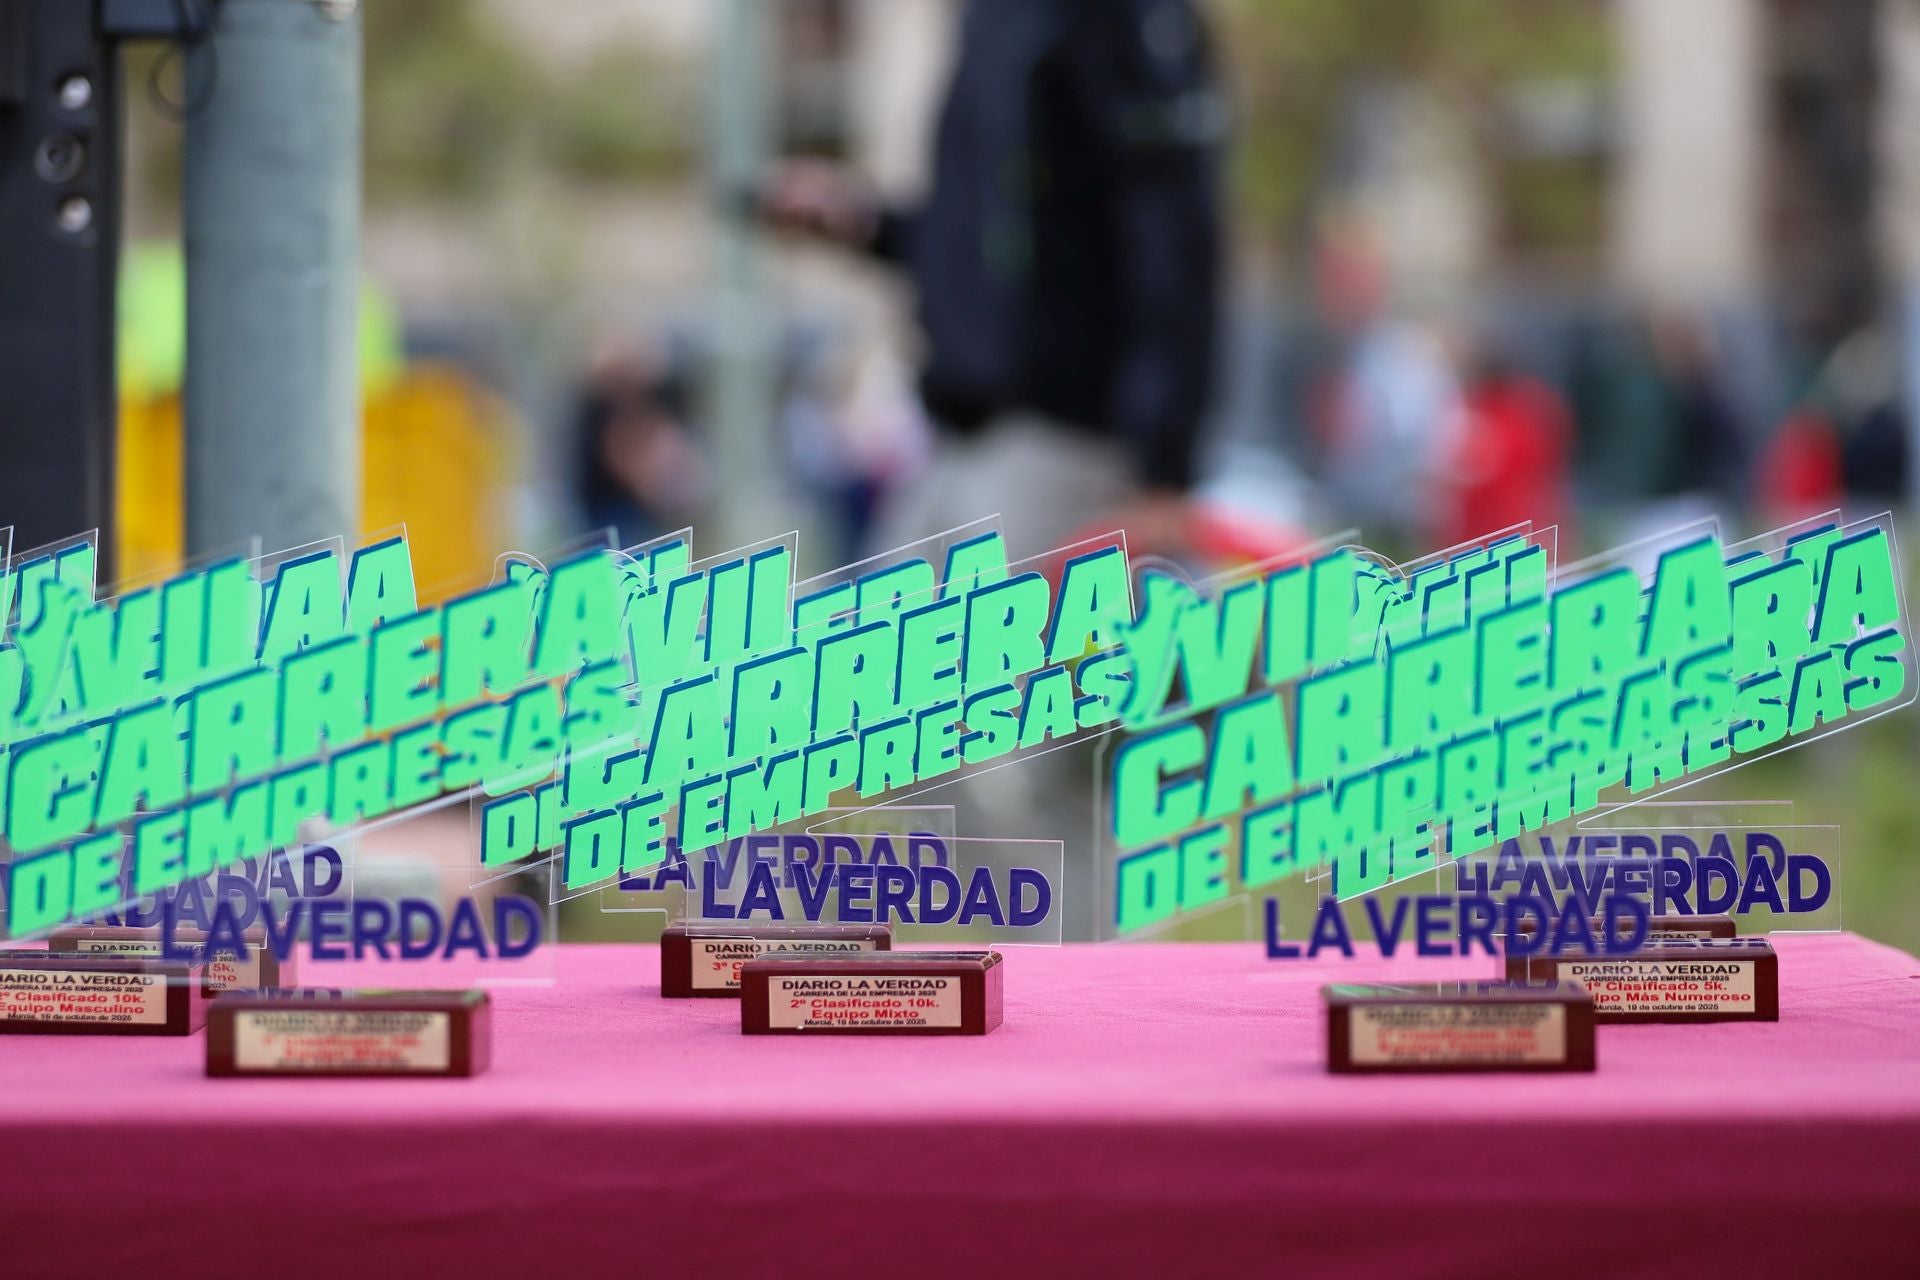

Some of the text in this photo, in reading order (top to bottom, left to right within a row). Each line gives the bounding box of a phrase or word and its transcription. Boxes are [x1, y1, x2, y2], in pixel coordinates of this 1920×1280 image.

[1112, 534, 1730, 848] CARRERA
[6, 547, 621, 853] CARRERA
[562, 646, 1133, 891] DE EMPRESAS
[1116, 645, 1736, 934] DE EMPRESAS
[9, 660, 631, 940] DE EMPRESAS
[702, 860, 1052, 927] LA VERDAD
[160, 894, 543, 962] LA VERDAD
[1265, 891, 1650, 958] LA VERDAD
[705, 944, 761, 952] DIARIO
[792, 944, 860, 952] VERDAD
[1572, 964, 1740, 974] DIARIO LA VERDAD
[0, 974, 154, 986] IARIO LA VERDAD
[782, 980, 947, 990] DIARIO LA VERDAD
[1606, 982, 1699, 991] Clasificado
[1704, 982, 1727, 990] 5k.
[15, 992, 108, 1003] Clasificado
[114, 994, 146, 1004] 10k.
[811, 998, 902, 1008] Clasificado
[908, 998, 940, 1008] 10k.
[1593, 992, 1751, 1003] ipo Más Numeroso
[0, 1002, 145, 1014] Equipo Masculino
[1594, 1004, 1624, 1012] Murcia,
[812, 1010, 920, 1020] Equipo Mixto
